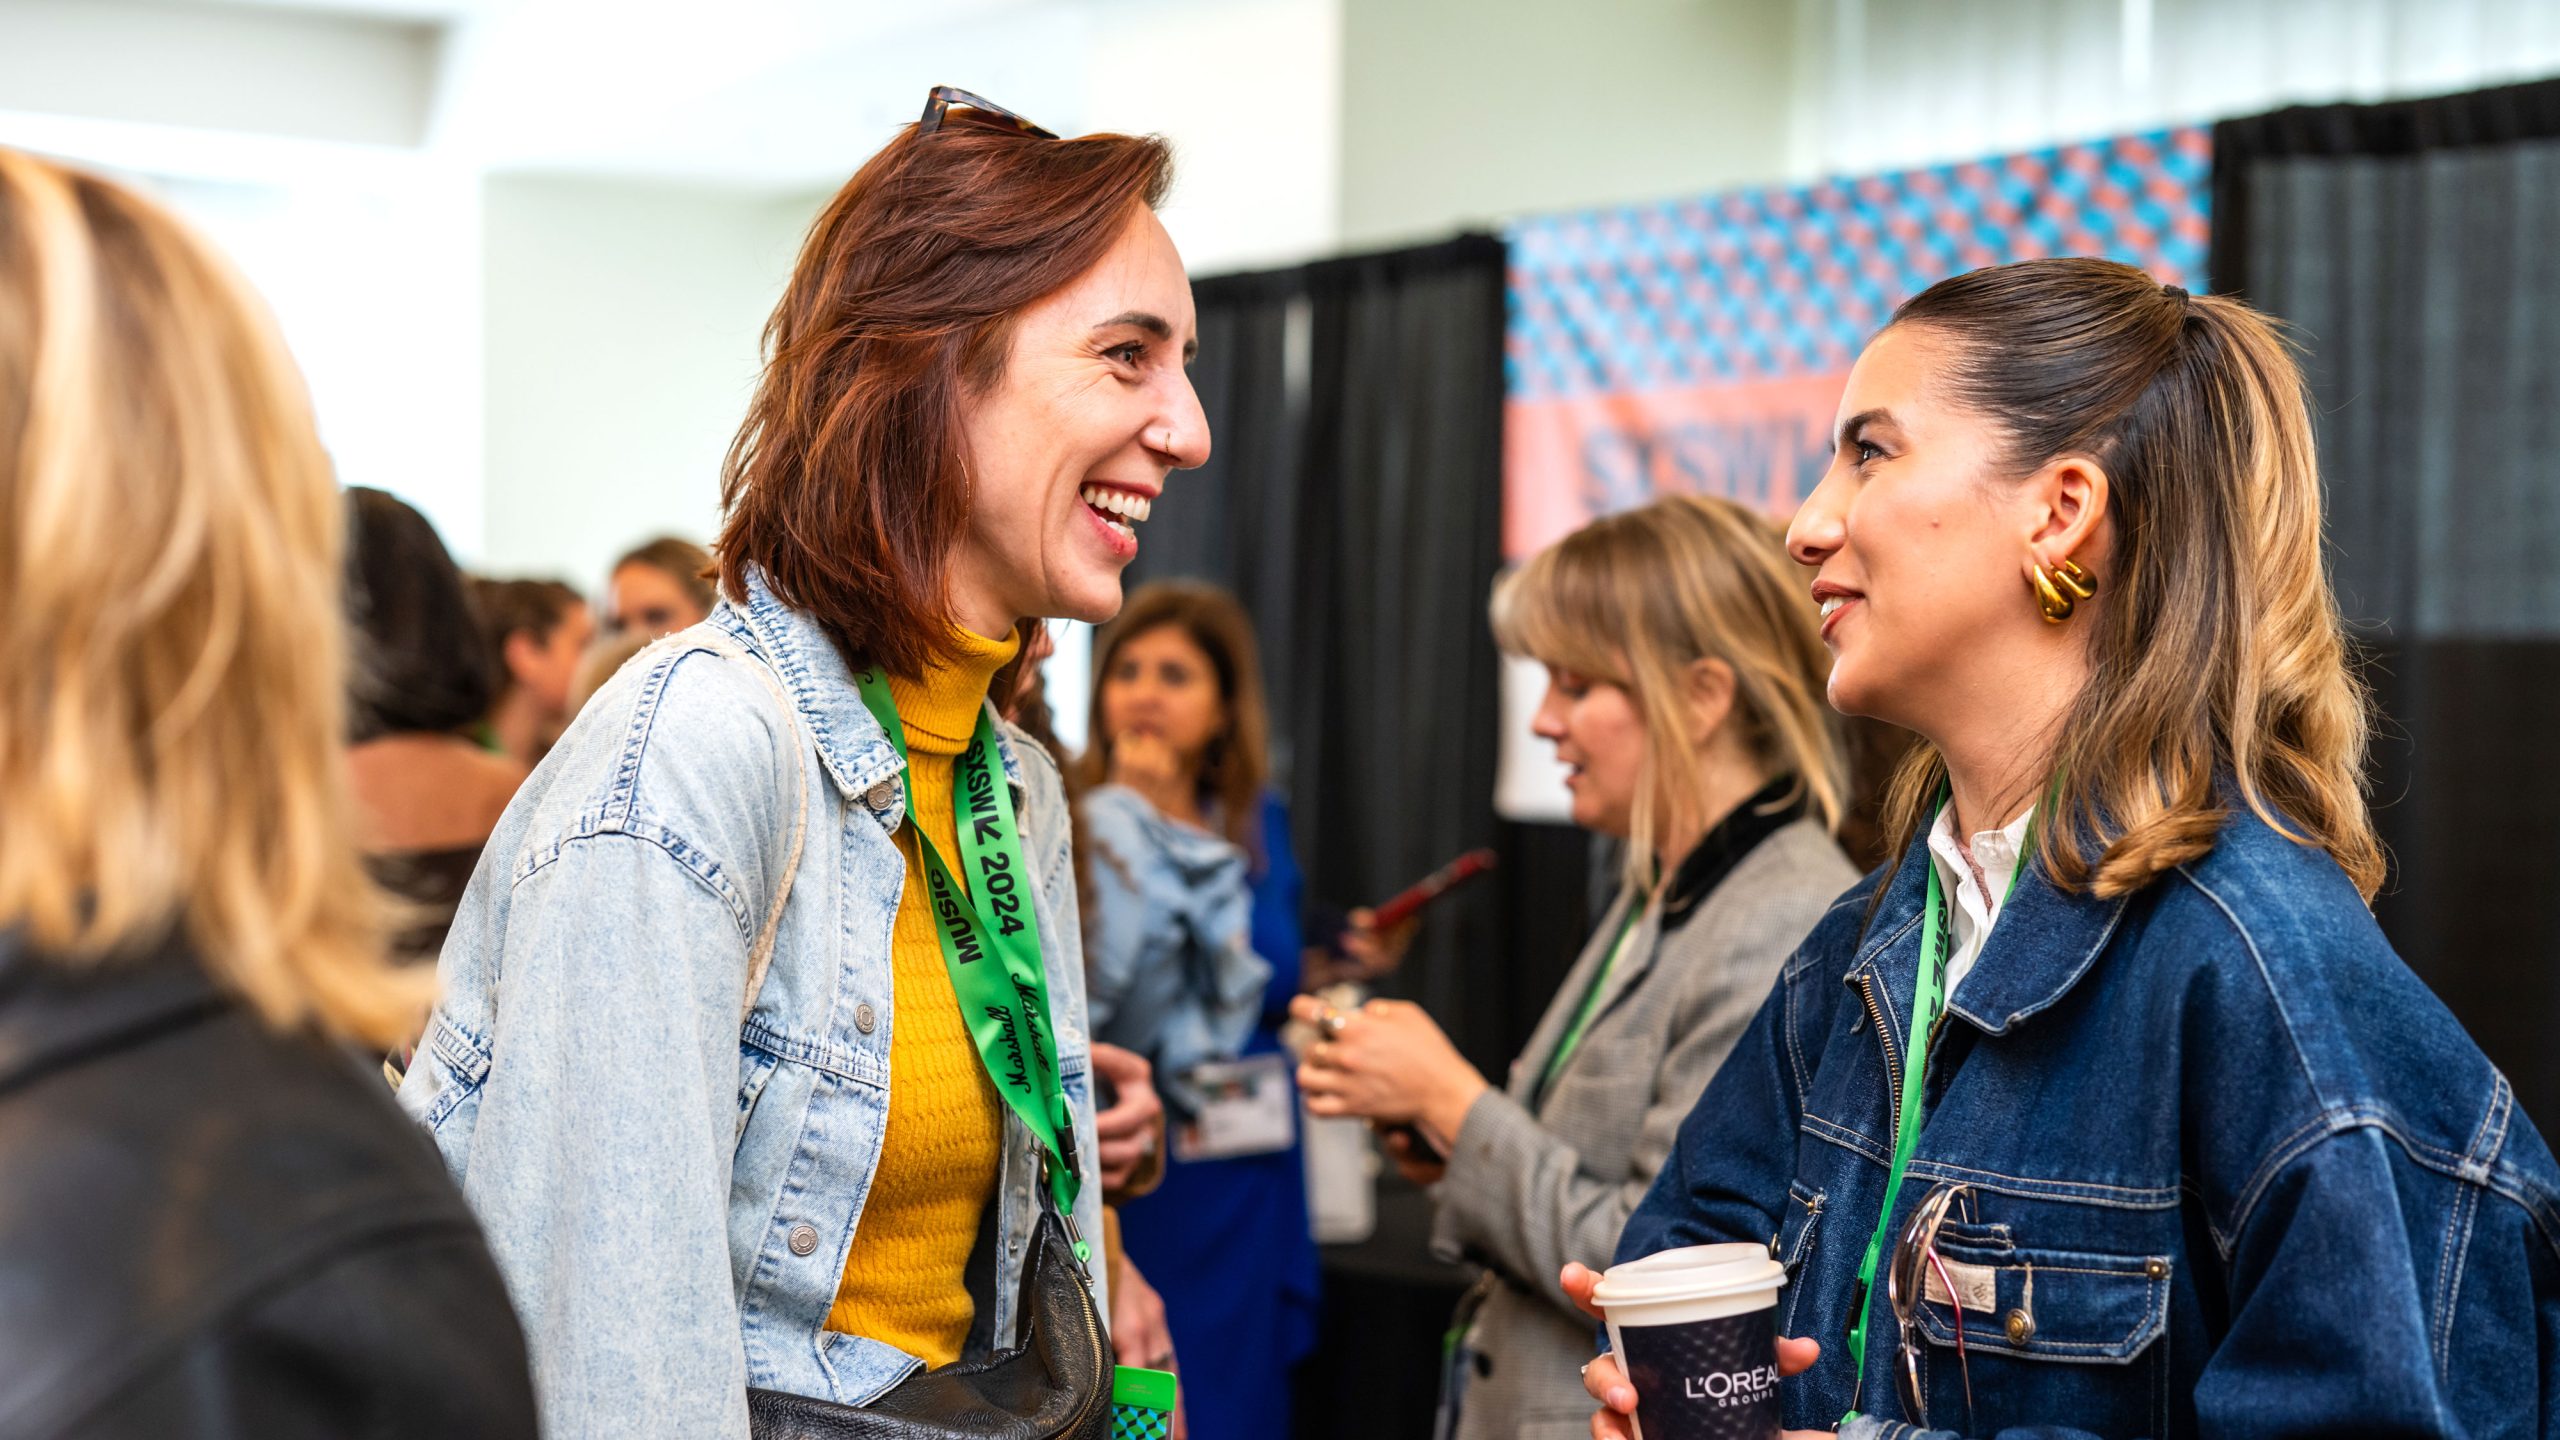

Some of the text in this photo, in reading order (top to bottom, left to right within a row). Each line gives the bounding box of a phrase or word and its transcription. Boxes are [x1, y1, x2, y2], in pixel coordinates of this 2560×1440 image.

[931, 868, 983, 964] MUSIC
[980, 852, 1025, 936] 2024
[985, 1005, 1031, 1094] Marshall
